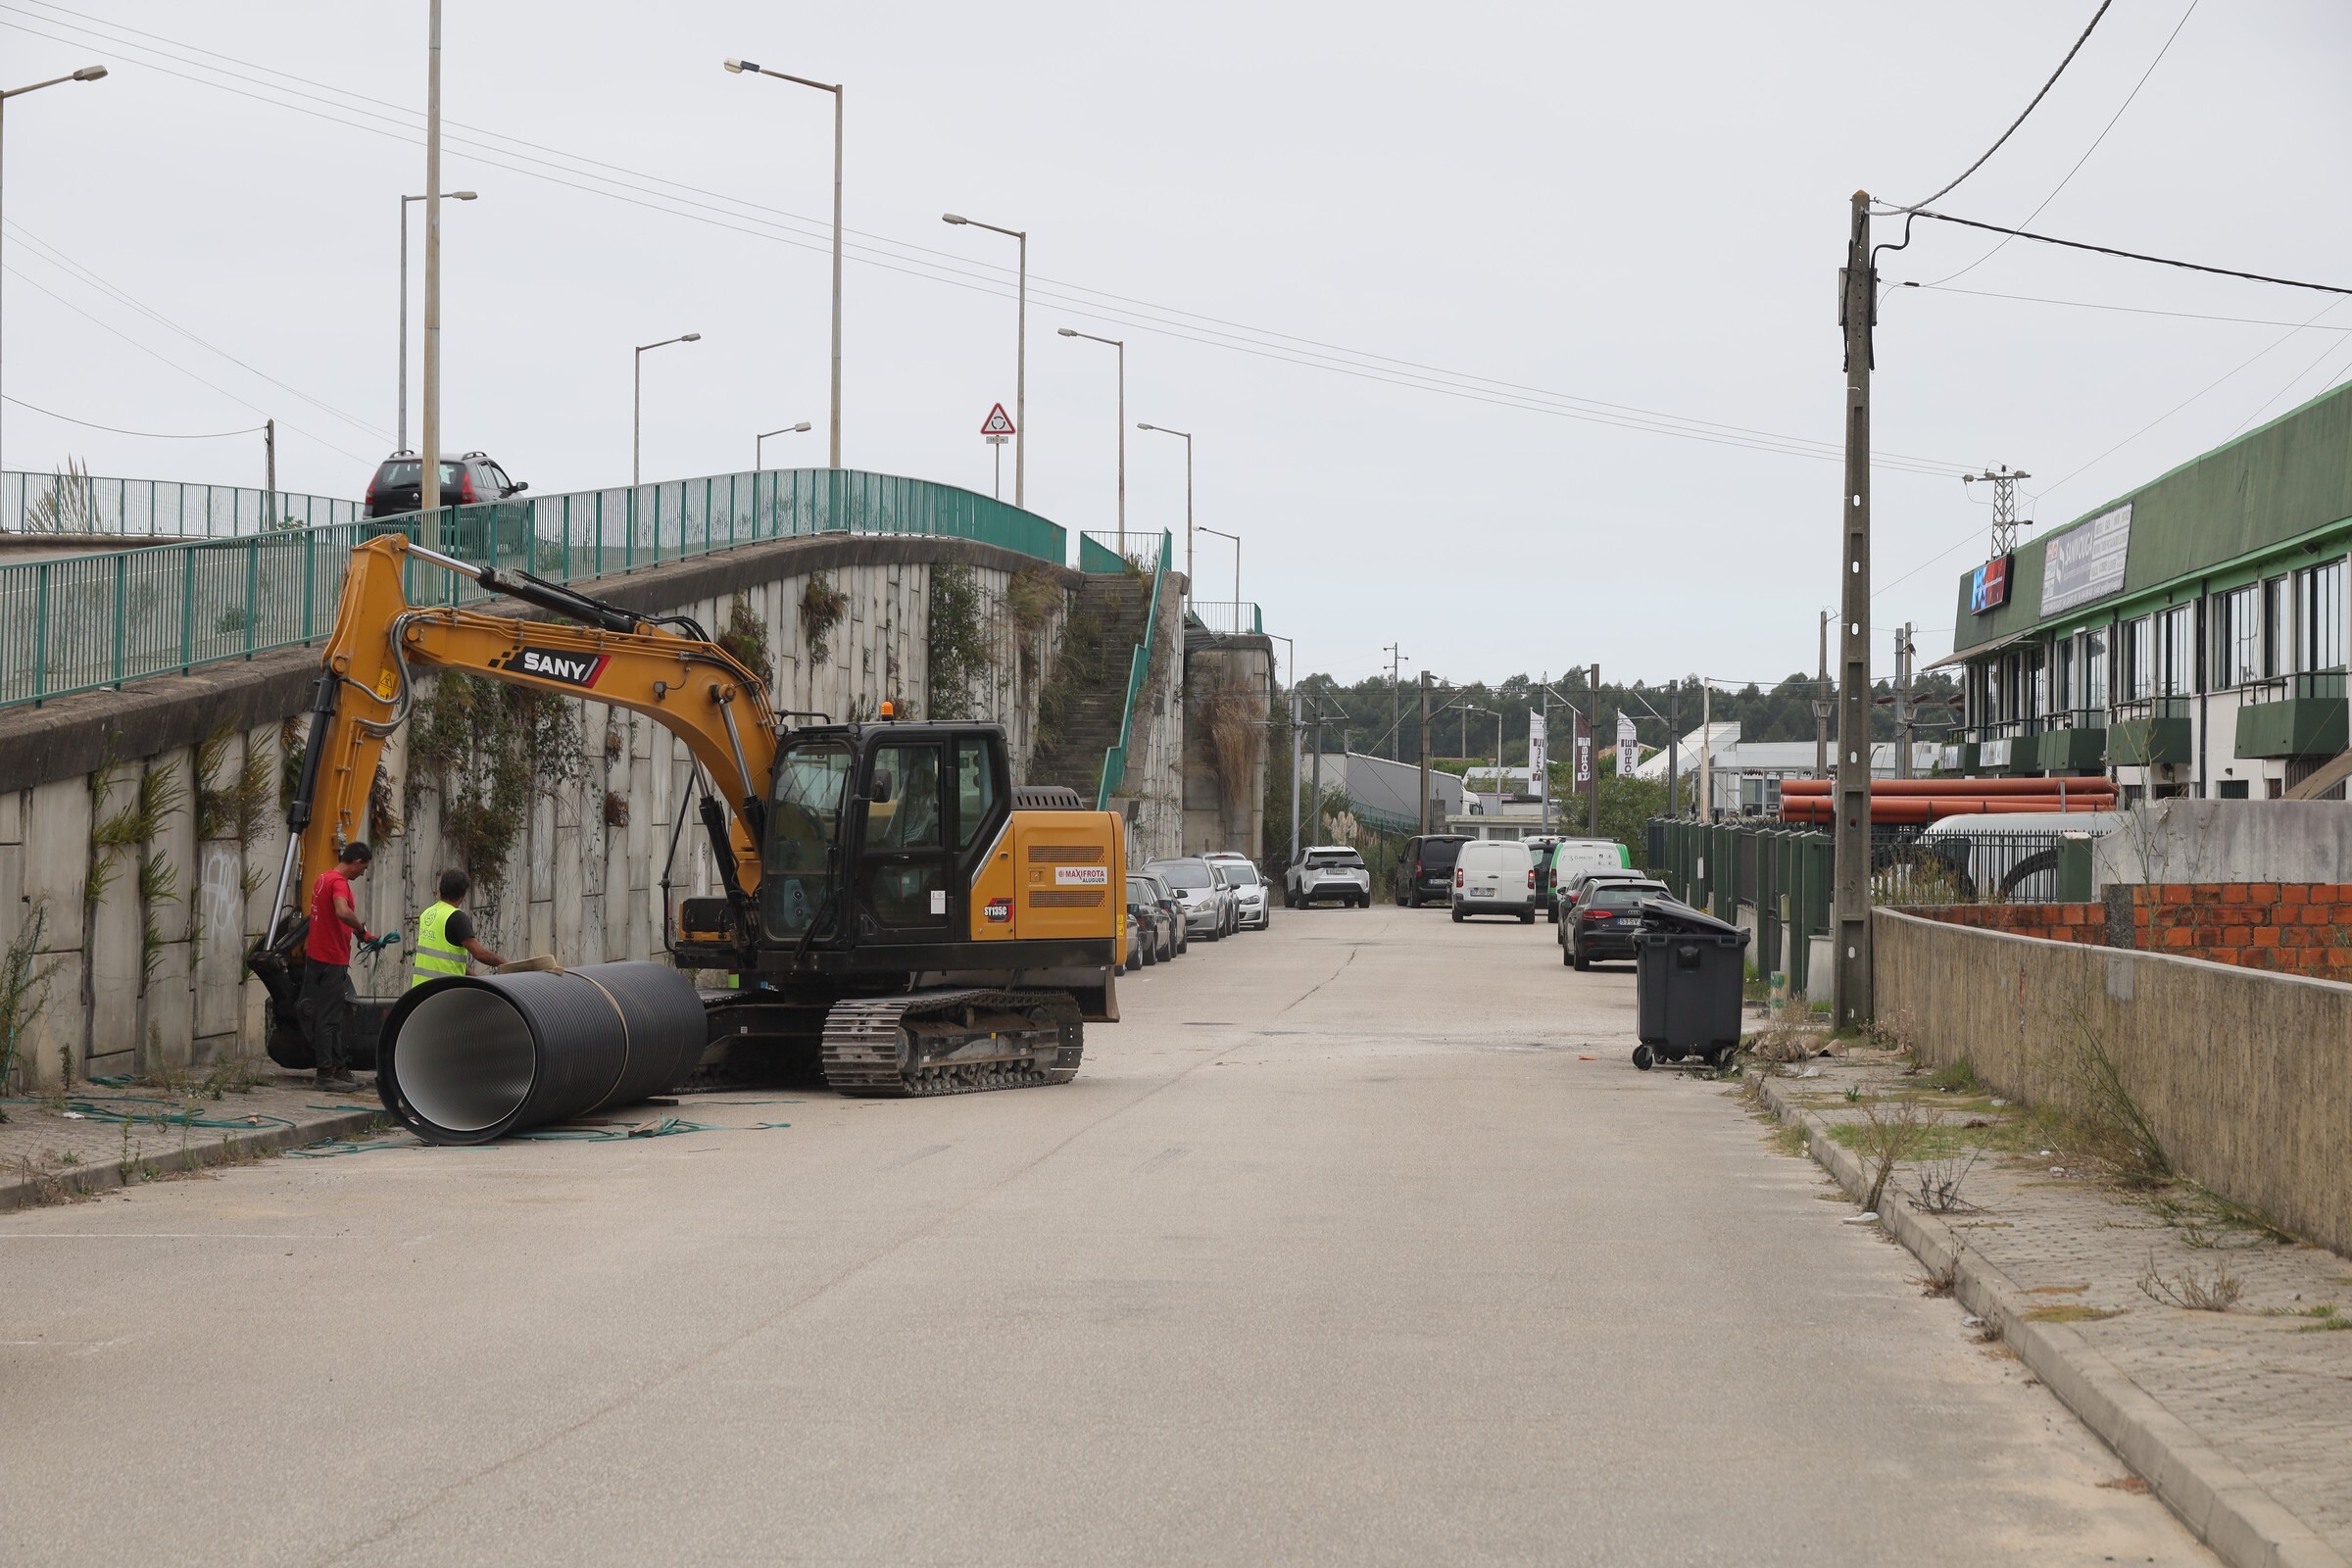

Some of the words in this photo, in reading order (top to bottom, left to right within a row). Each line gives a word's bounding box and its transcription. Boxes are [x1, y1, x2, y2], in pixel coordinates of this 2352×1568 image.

[524, 652, 586, 680] SANY
[1065, 868, 1105, 880] MAXIFROTA
[984, 906, 1007, 916] SY135C
